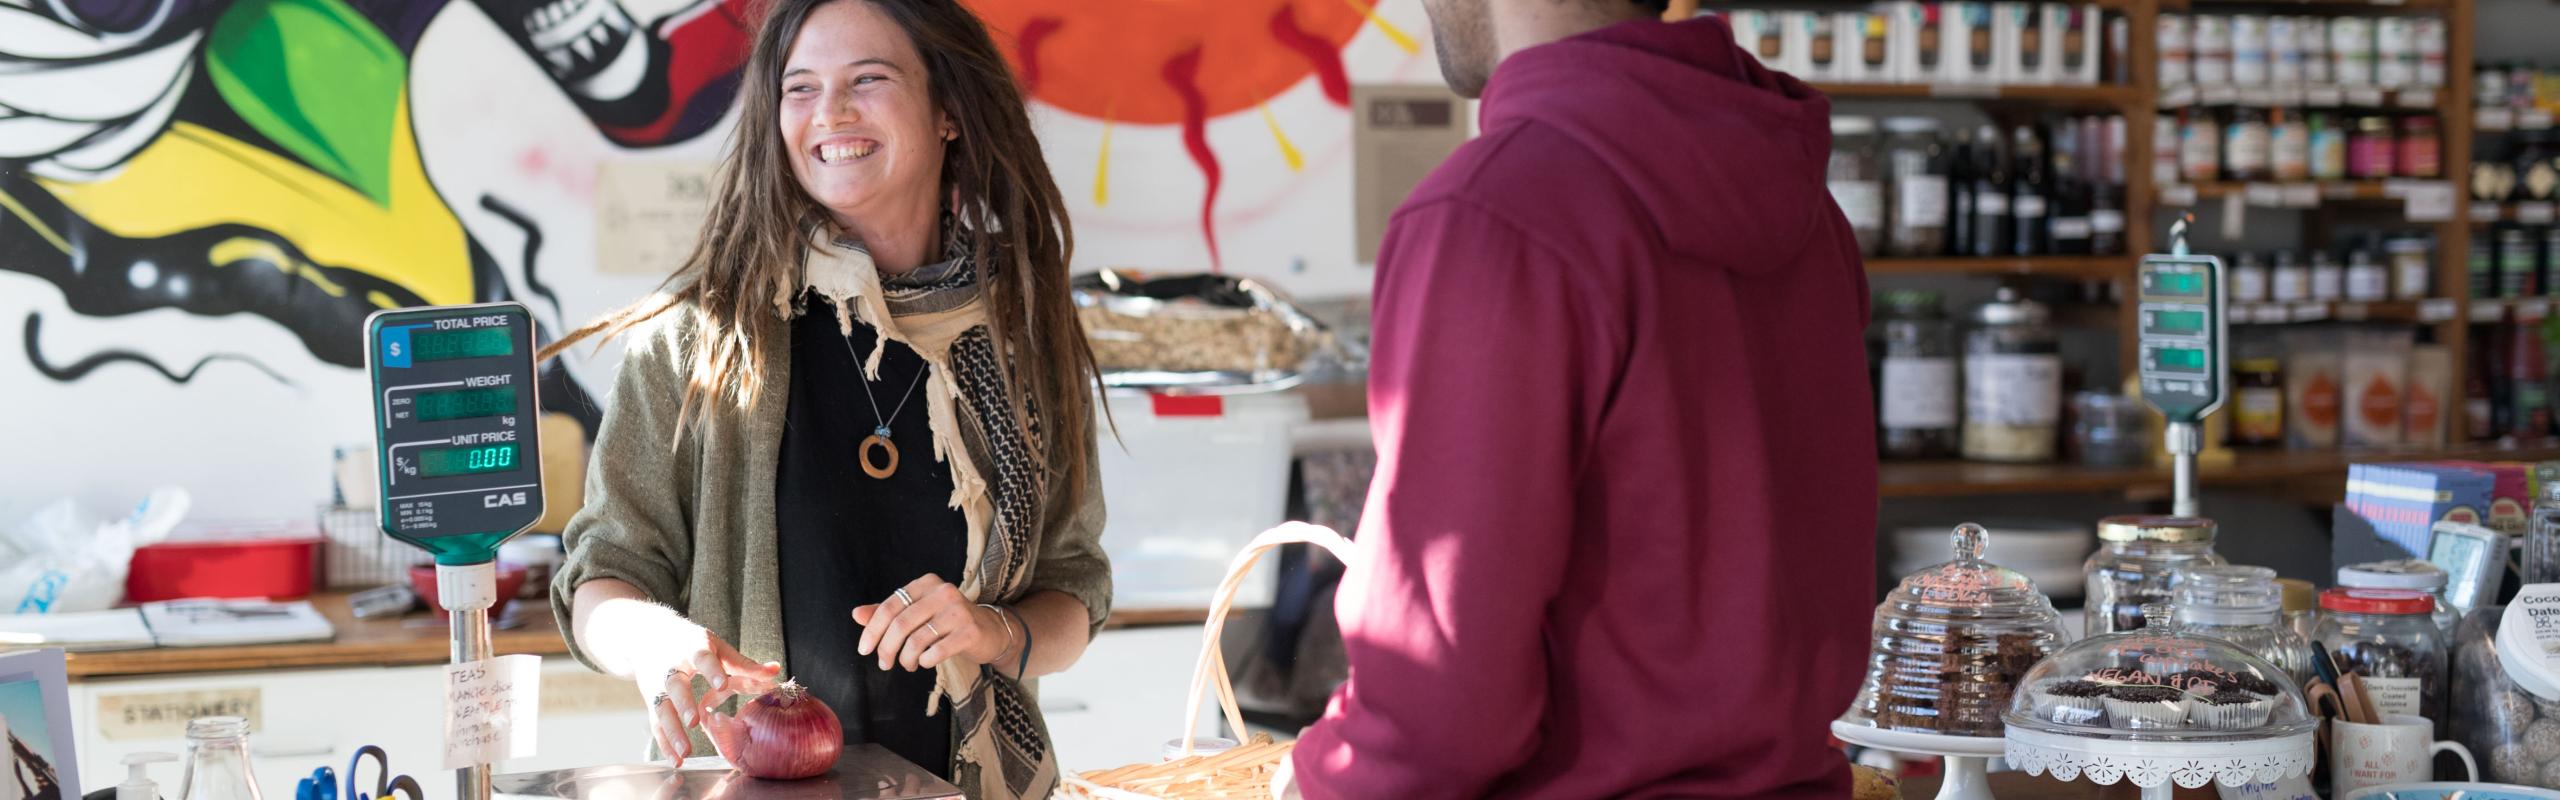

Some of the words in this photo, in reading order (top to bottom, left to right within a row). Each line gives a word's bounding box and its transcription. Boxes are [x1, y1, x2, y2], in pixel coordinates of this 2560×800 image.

[434, 318, 471, 330] TOTAL
[473, 315, 508, 327] PRICE
[390, 342, 401, 357] $
[465, 374, 512, 387] WEIGHT
[392, 398, 411, 406] ZERO
[395, 411, 409, 419] NET
[502, 416, 515, 427] kg
[452, 433, 479, 446] UNIT
[481, 430, 516, 442] PRICE
[469, 447, 511, 469] 0.00
[484, 492, 527, 508] CAS
[450, 664, 486, 685] TEAS
[2090, 669, 2161, 686] VEGAN
[2364, 761, 2379, 769] ALL
[2354, 770, 2379, 778] WANT
[2380, 771, 2397, 779] FOR
